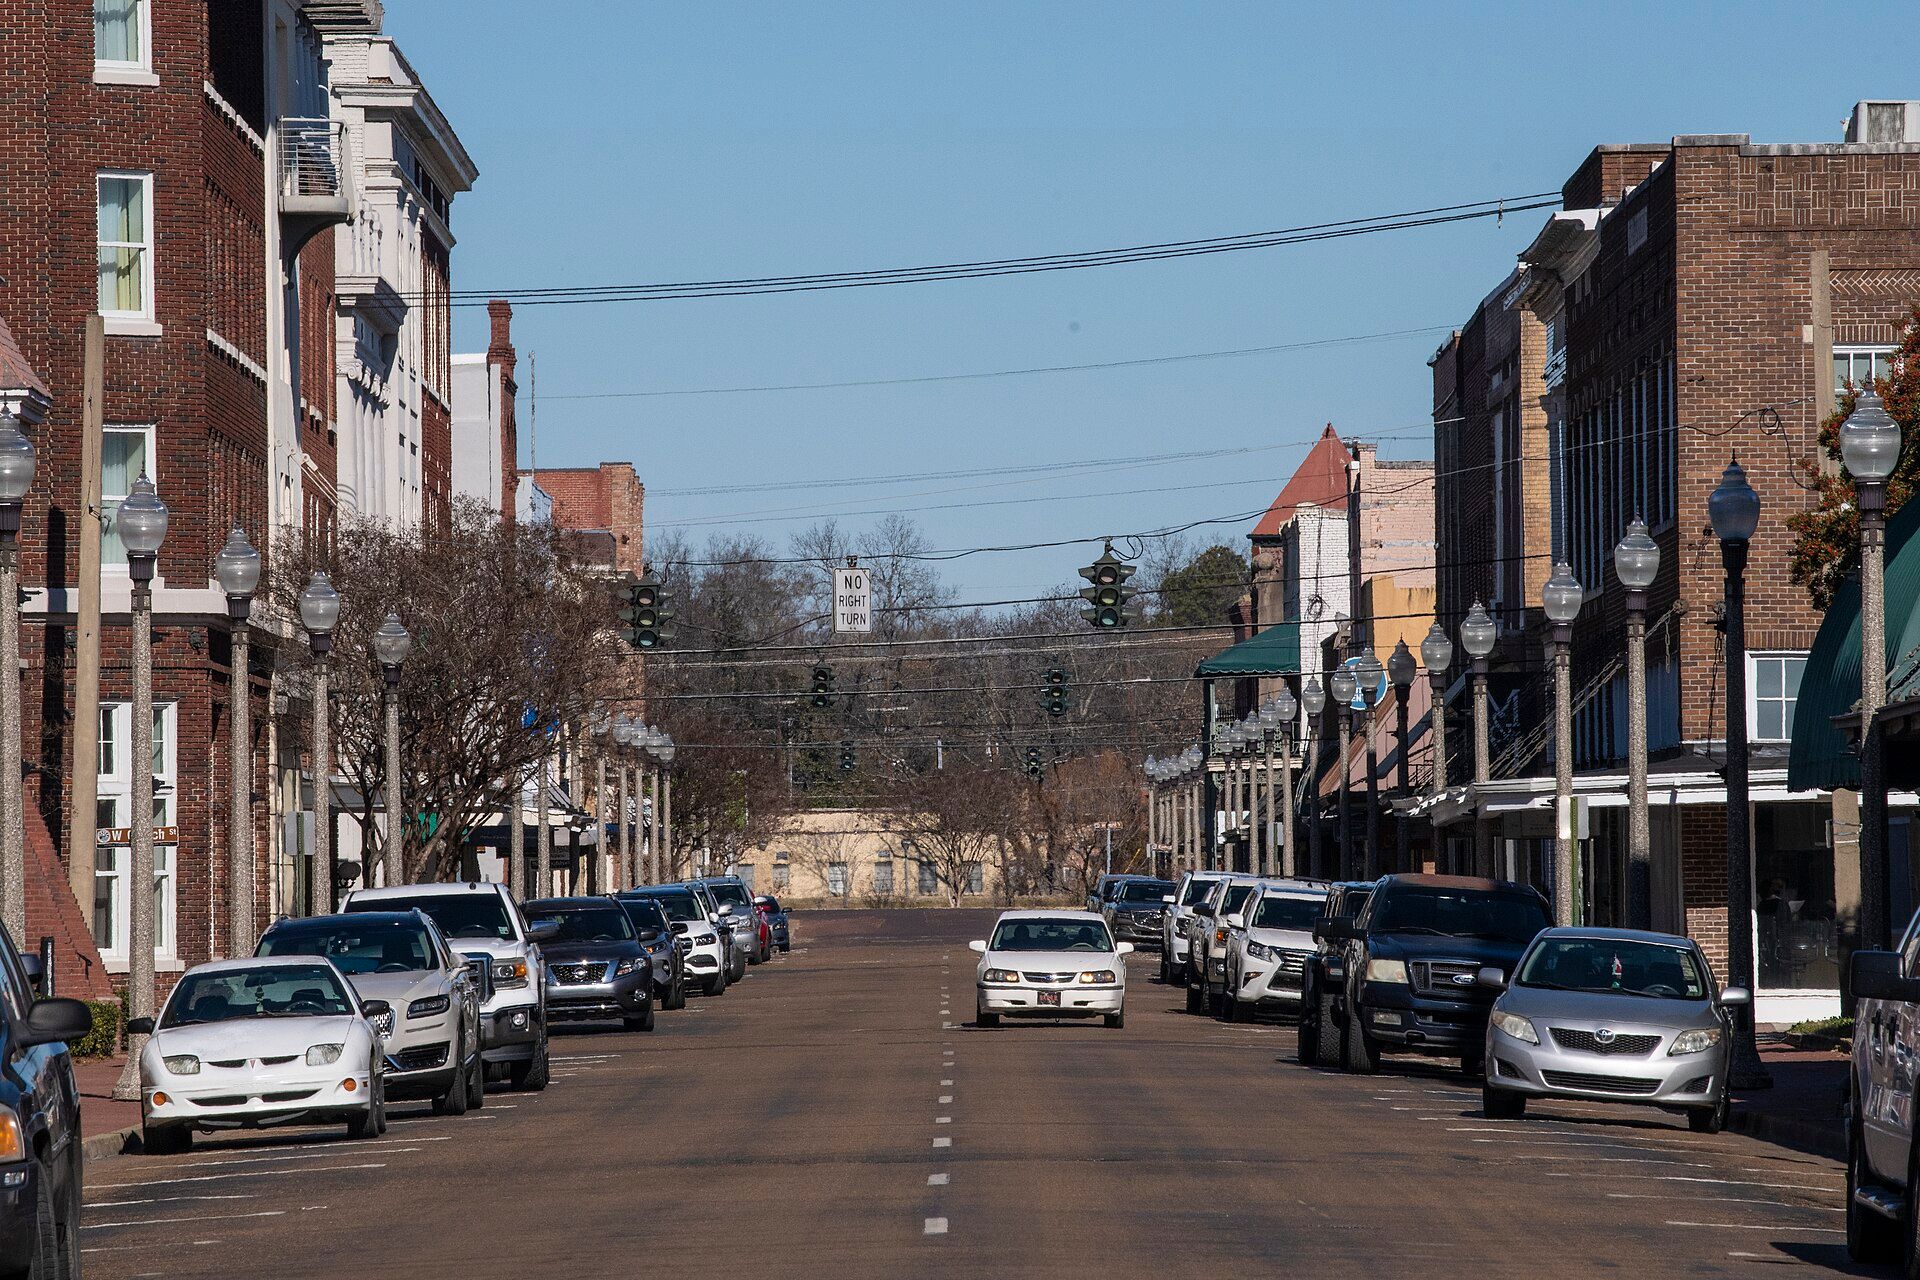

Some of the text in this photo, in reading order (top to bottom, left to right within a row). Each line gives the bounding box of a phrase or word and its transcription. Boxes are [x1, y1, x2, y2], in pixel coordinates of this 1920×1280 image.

[845, 575, 862, 589] NO
[839, 595, 866, 607] RIGHT
[841, 613, 866, 625] TURN
[112, 830, 122, 841] W
